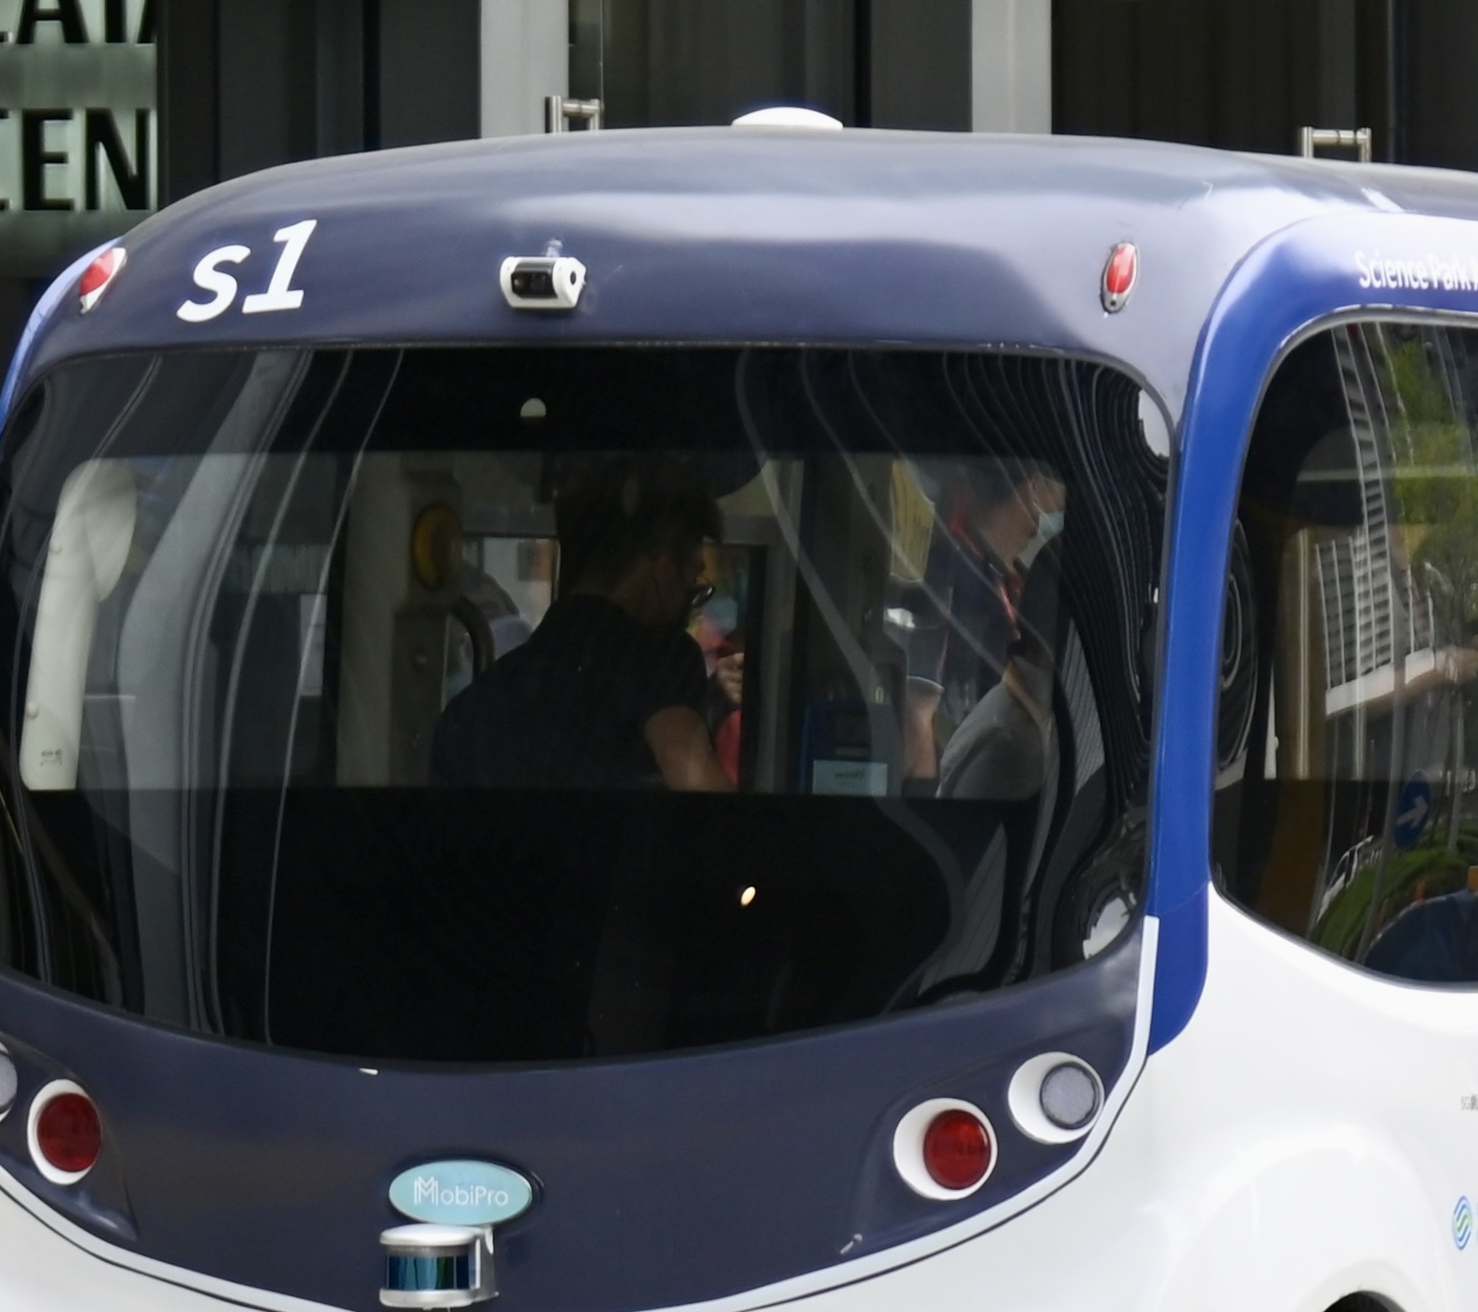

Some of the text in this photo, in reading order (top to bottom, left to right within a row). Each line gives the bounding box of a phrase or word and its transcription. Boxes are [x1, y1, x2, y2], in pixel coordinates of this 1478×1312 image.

[1354, 249, 1429, 290] Science
[1427, 253, 1472, 292] Park
[414, 1175, 510, 1207] MobiPro
